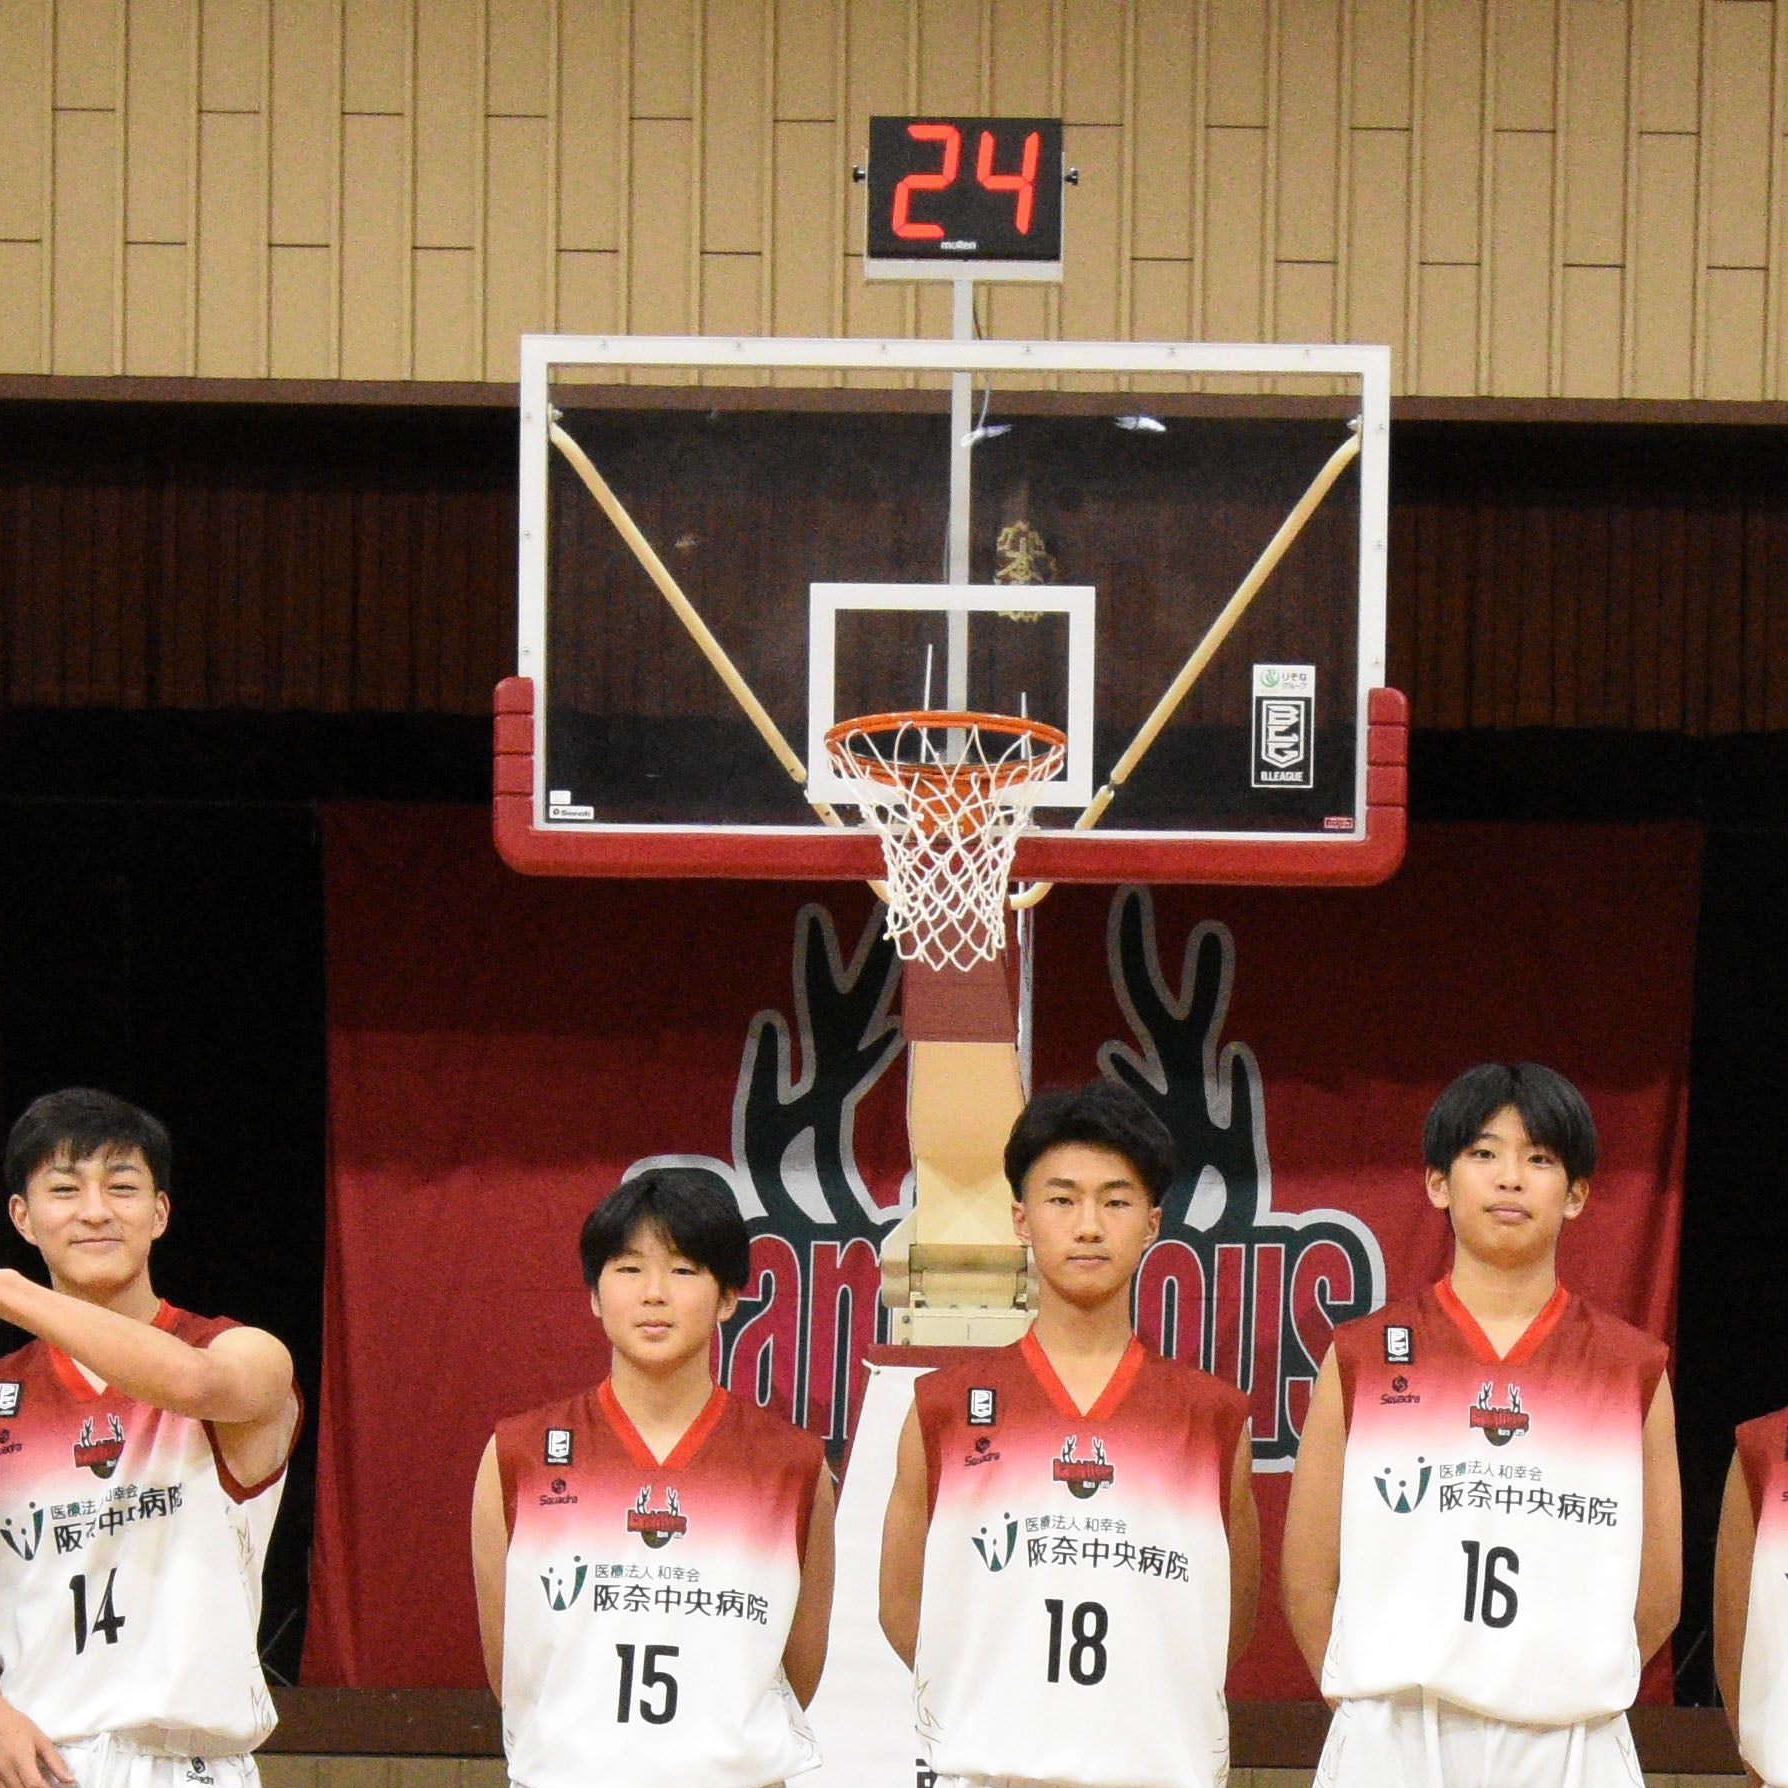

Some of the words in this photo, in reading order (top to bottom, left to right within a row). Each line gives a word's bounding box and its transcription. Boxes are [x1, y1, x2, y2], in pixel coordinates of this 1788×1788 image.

[892, 124, 1040, 239] 24
[941, 241, 976, 250] molten
[1282, 673, 1307, 681] りそな
[1439, 1460, 1494, 1479] 医療法人
[1025, 1514, 1081, 1533] 医療法人
[1439, 1479, 1618, 1528] 阪奈中央病院
[595, 1564, 653, 1580] 医療法人
[1027, 1535, 1189, 1582] 阪奈中央病院
[593, 1584, 769, 1625] 阪奈中央病院
[1461, 1540, 1519, 1628] 16
[68, 1567, 126, 1655] 14
[1044, 1598, 1108, 1686] 18
[615, 1643, 679, 1725] 15
